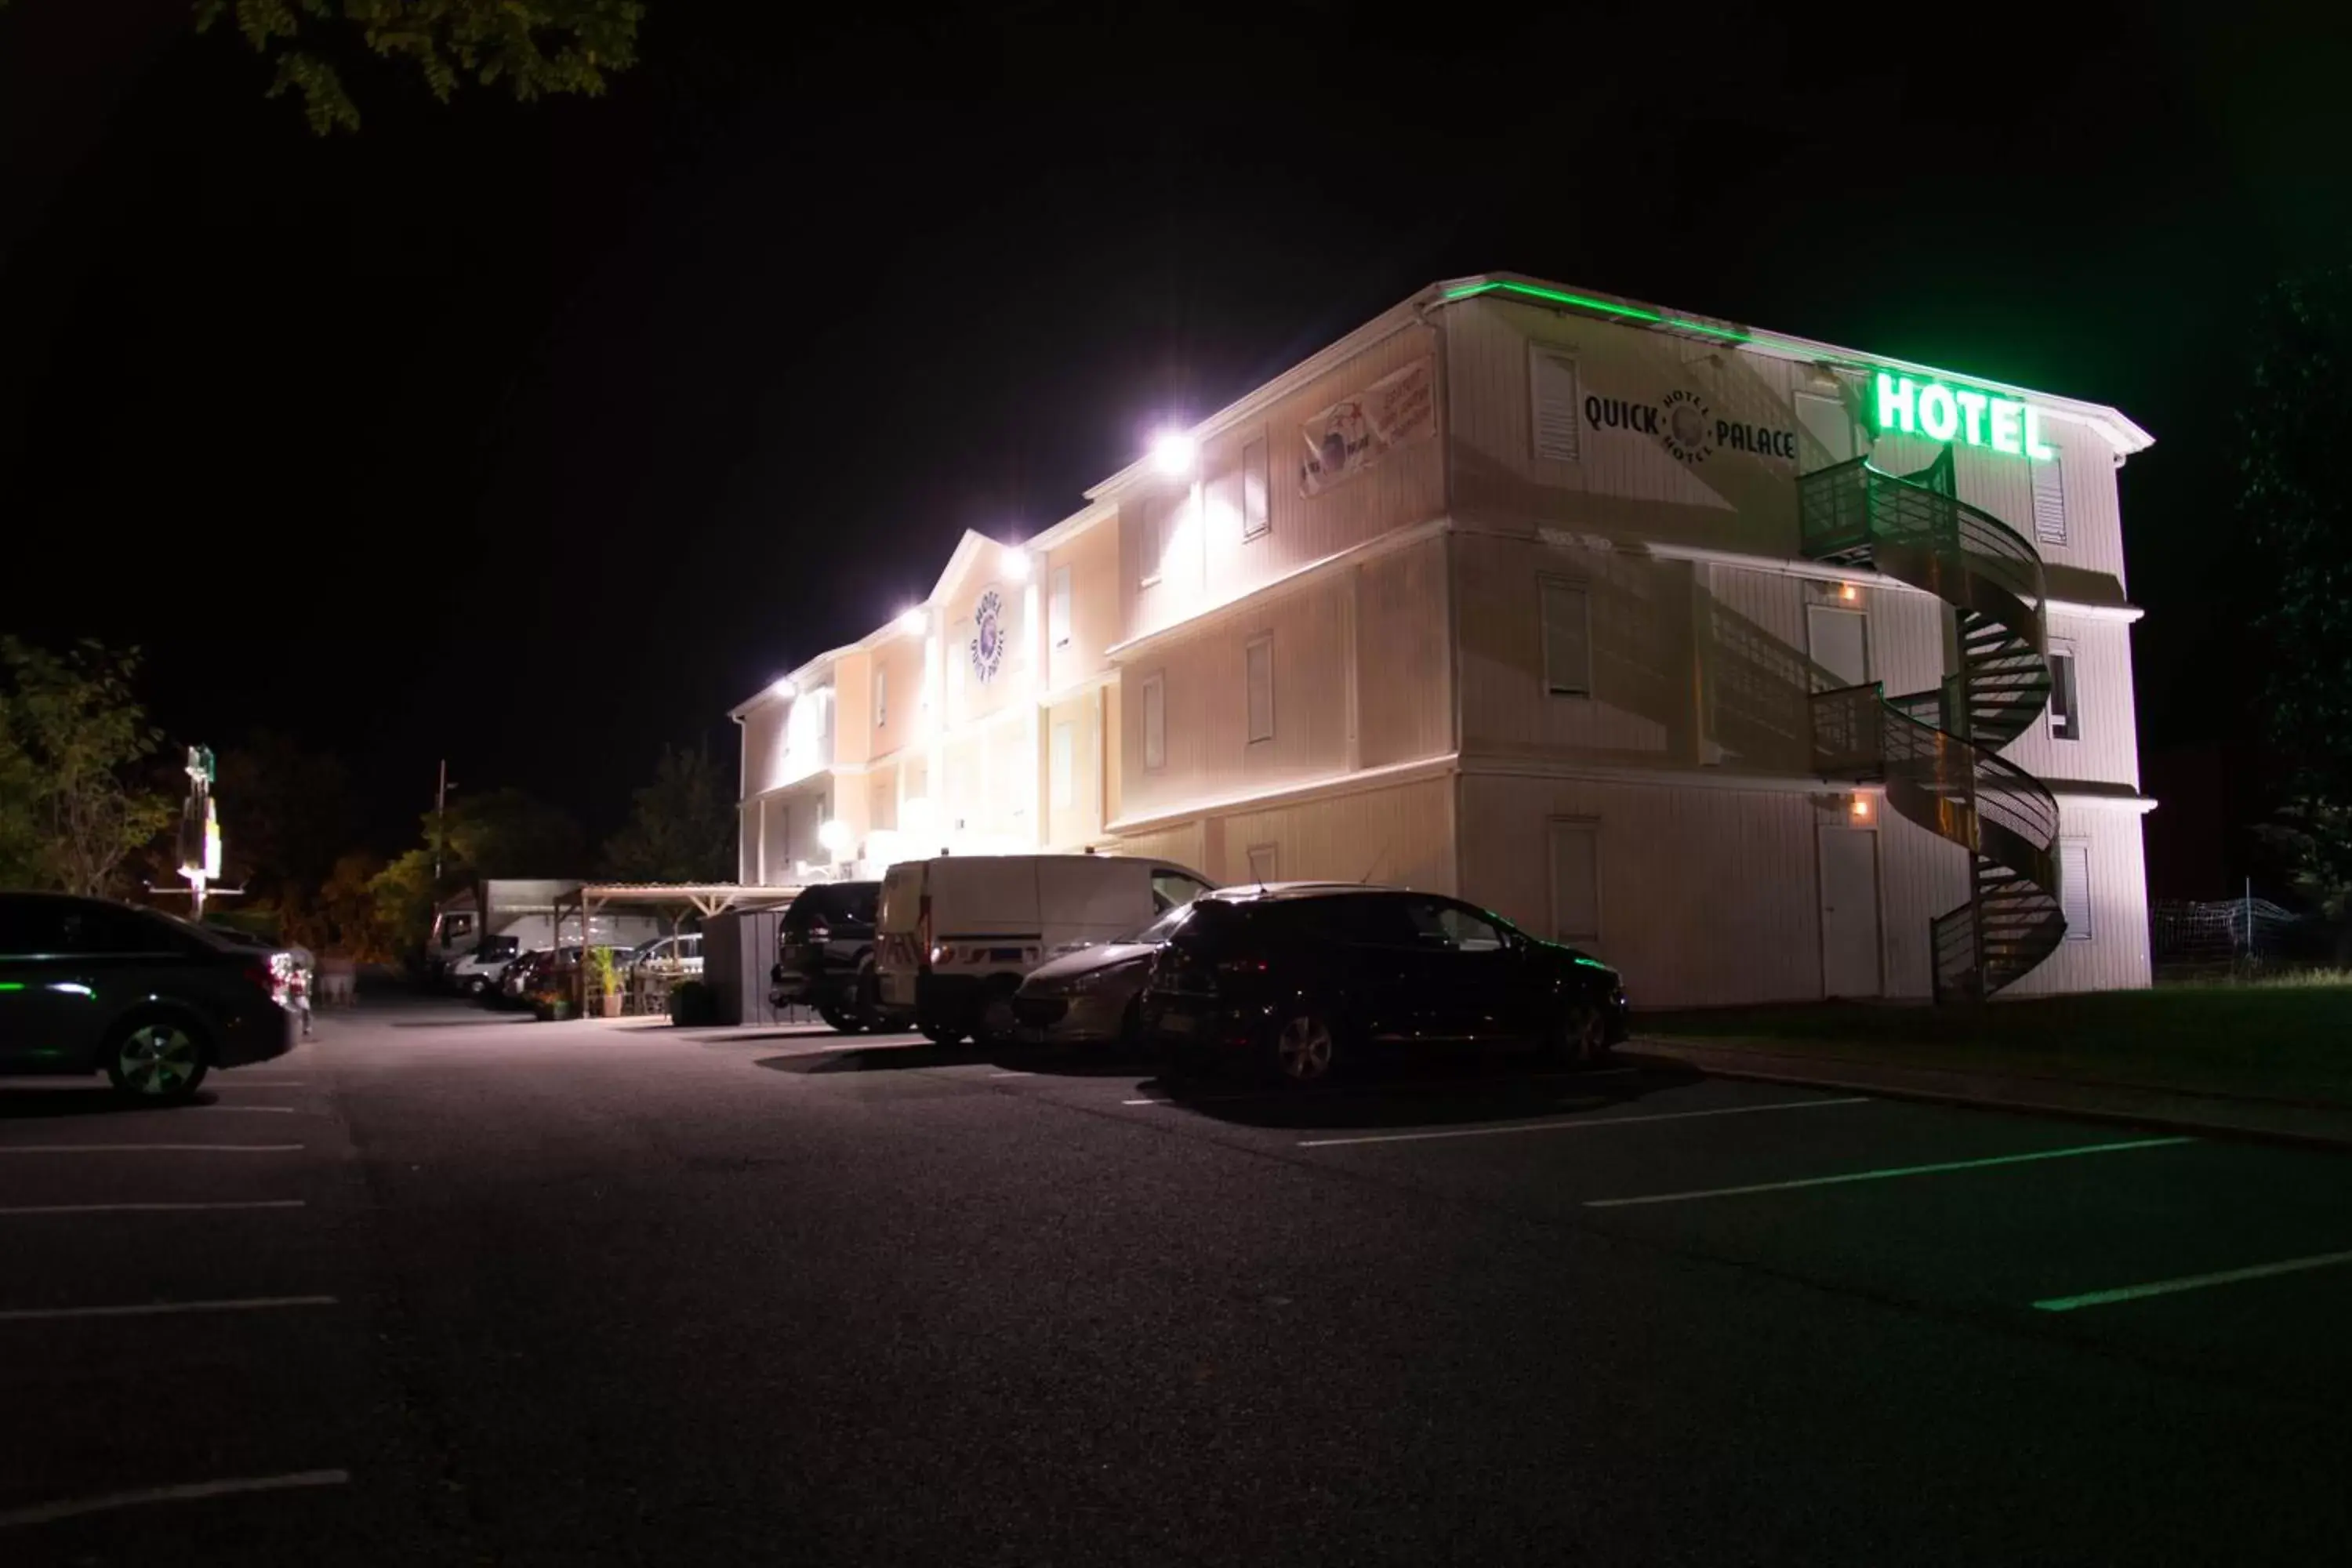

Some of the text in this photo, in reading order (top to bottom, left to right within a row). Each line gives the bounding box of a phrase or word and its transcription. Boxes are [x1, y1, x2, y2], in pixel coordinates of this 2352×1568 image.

[1663, 390, 1709, 416] HOTEL
[1877, 372, 2053, 460] HOTEL
[1584, 396, 1795, 459] QUICK PALACE
[1664, 435, 1713, 464] HOTEL
